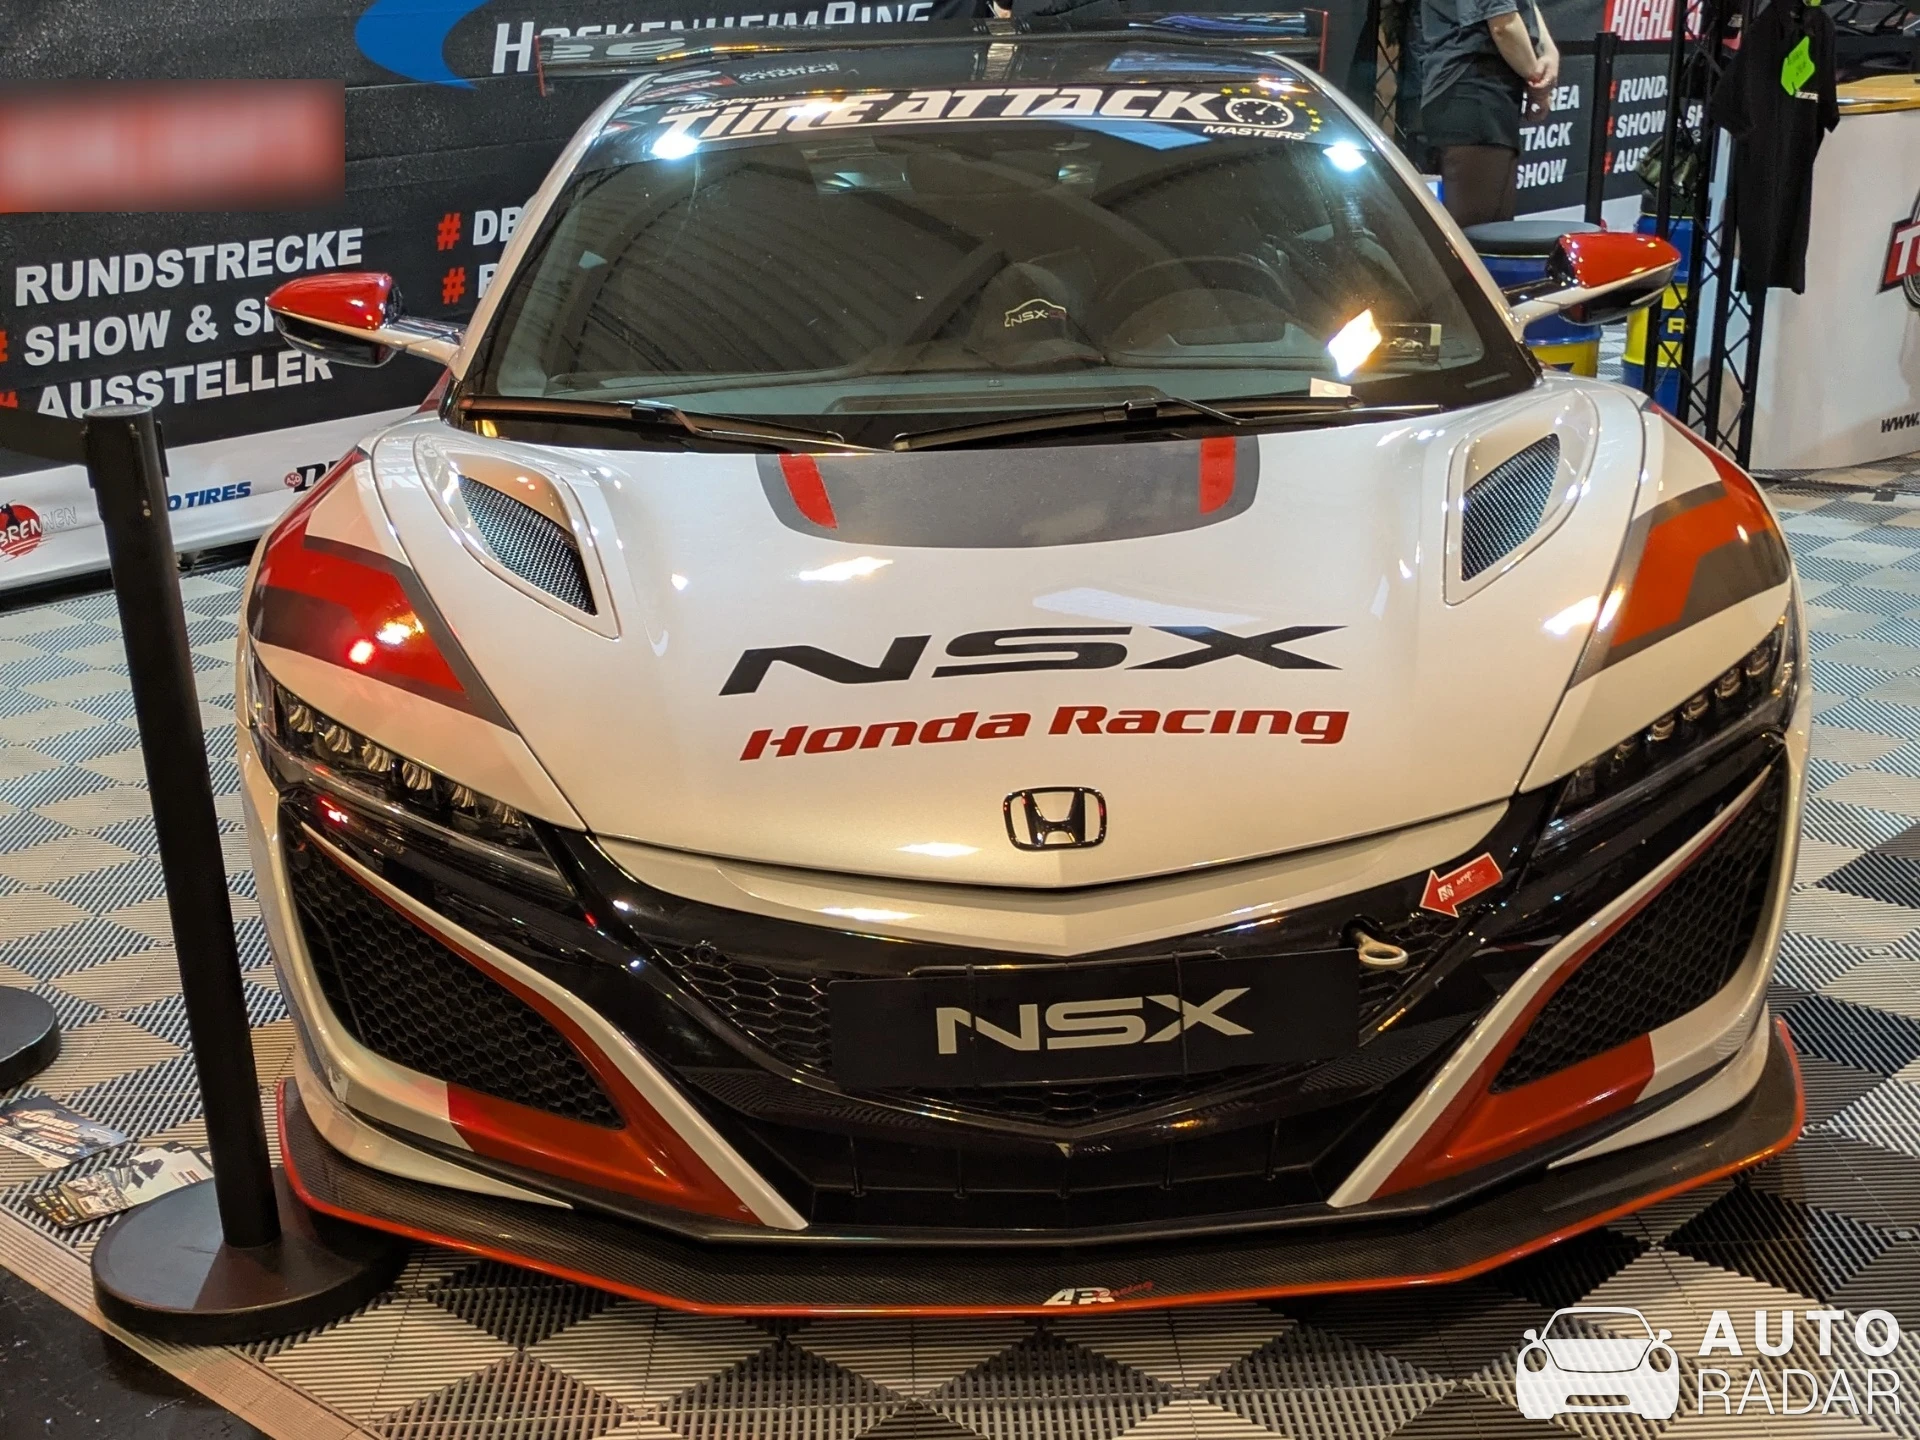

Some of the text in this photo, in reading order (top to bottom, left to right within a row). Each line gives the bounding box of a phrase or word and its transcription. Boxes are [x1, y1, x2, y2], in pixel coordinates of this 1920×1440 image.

[1618, 75, 1668, 103] RUND
[1203, 125, 1306, 140] MASTERS
[1519, 122, 1574, 151] TACK
[1615, 109, 1667, 138] SHOW
[15, 228, 363, 307] RUNDSTRECKE
[24, 309, 171, 366] SHOW
[186, 304, 219, 343] &
[37, 350, 333, 420] AUSSTELLER
[185, 481, 251, 508] TIRES
[719, 625, 1348, 697] NSX
[740, 705, 1350, 761] Honda Racing
[936, 987, 1254, 1055] NSX
